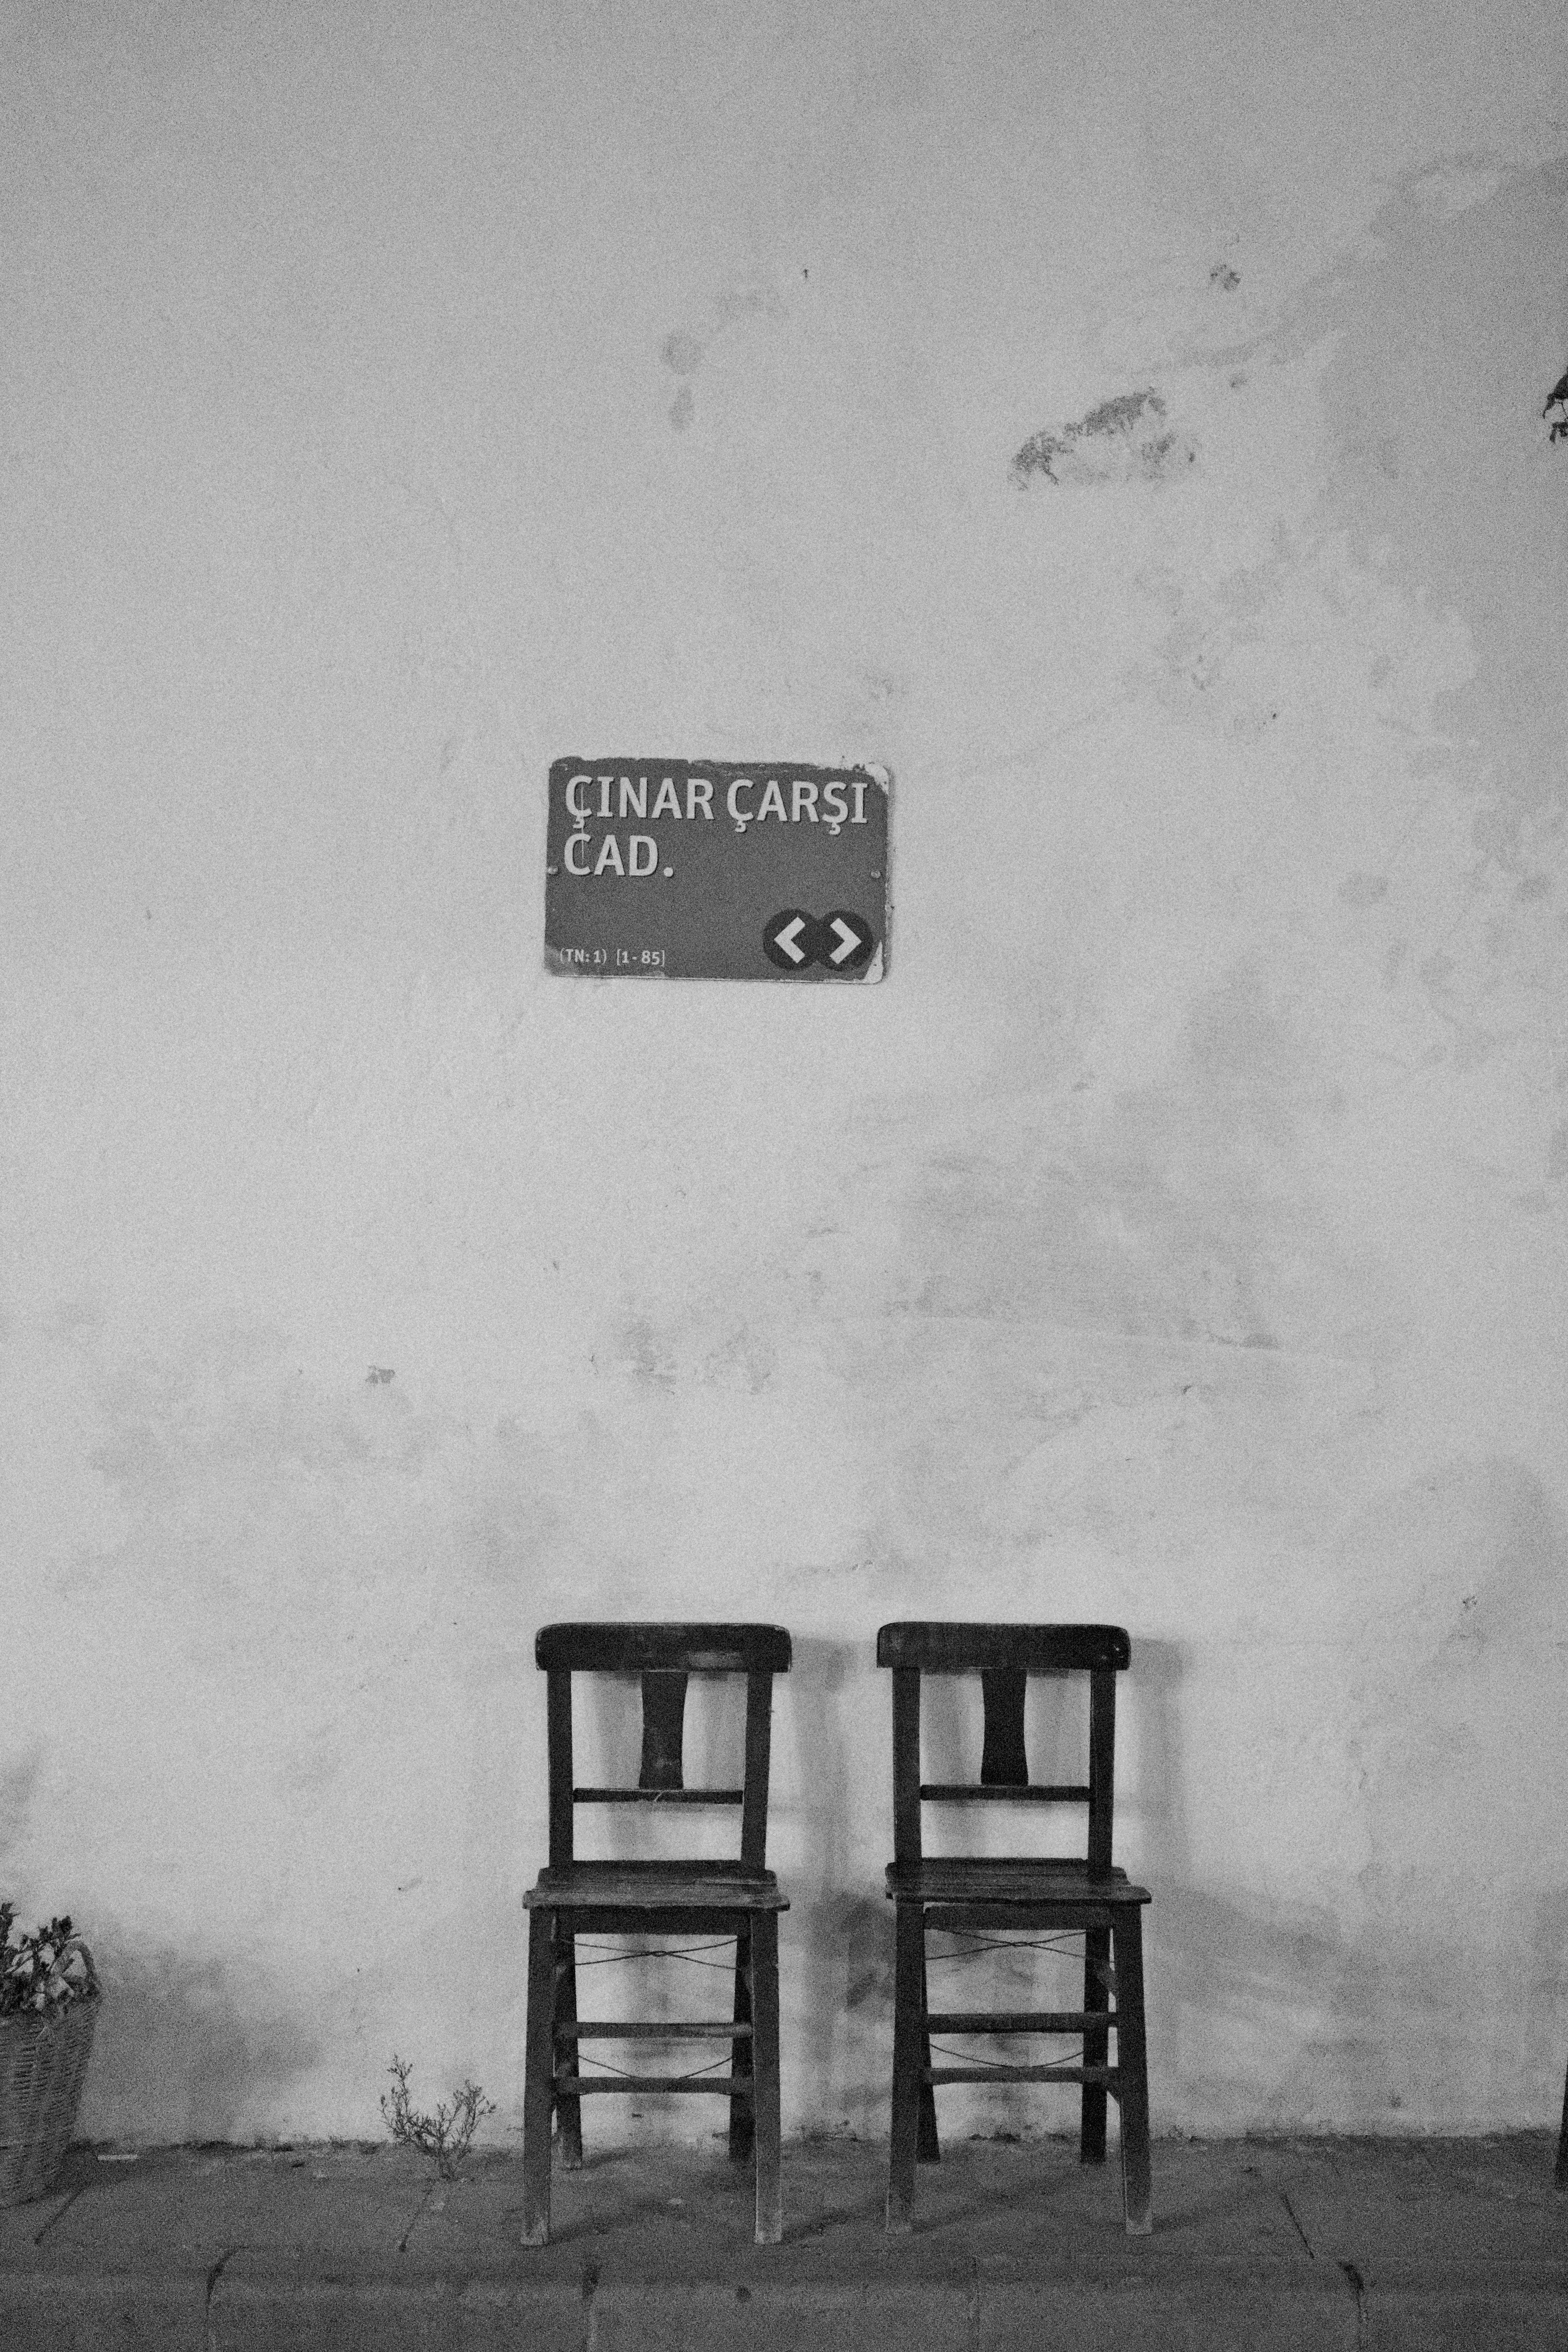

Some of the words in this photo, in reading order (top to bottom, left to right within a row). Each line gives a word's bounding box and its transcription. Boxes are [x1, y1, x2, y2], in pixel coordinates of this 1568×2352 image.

[565, 775, 714, 828] ÇINAR
[727, 779, 867, 835] ÇARŞI
[564, 832, 674, 877] CAD.
